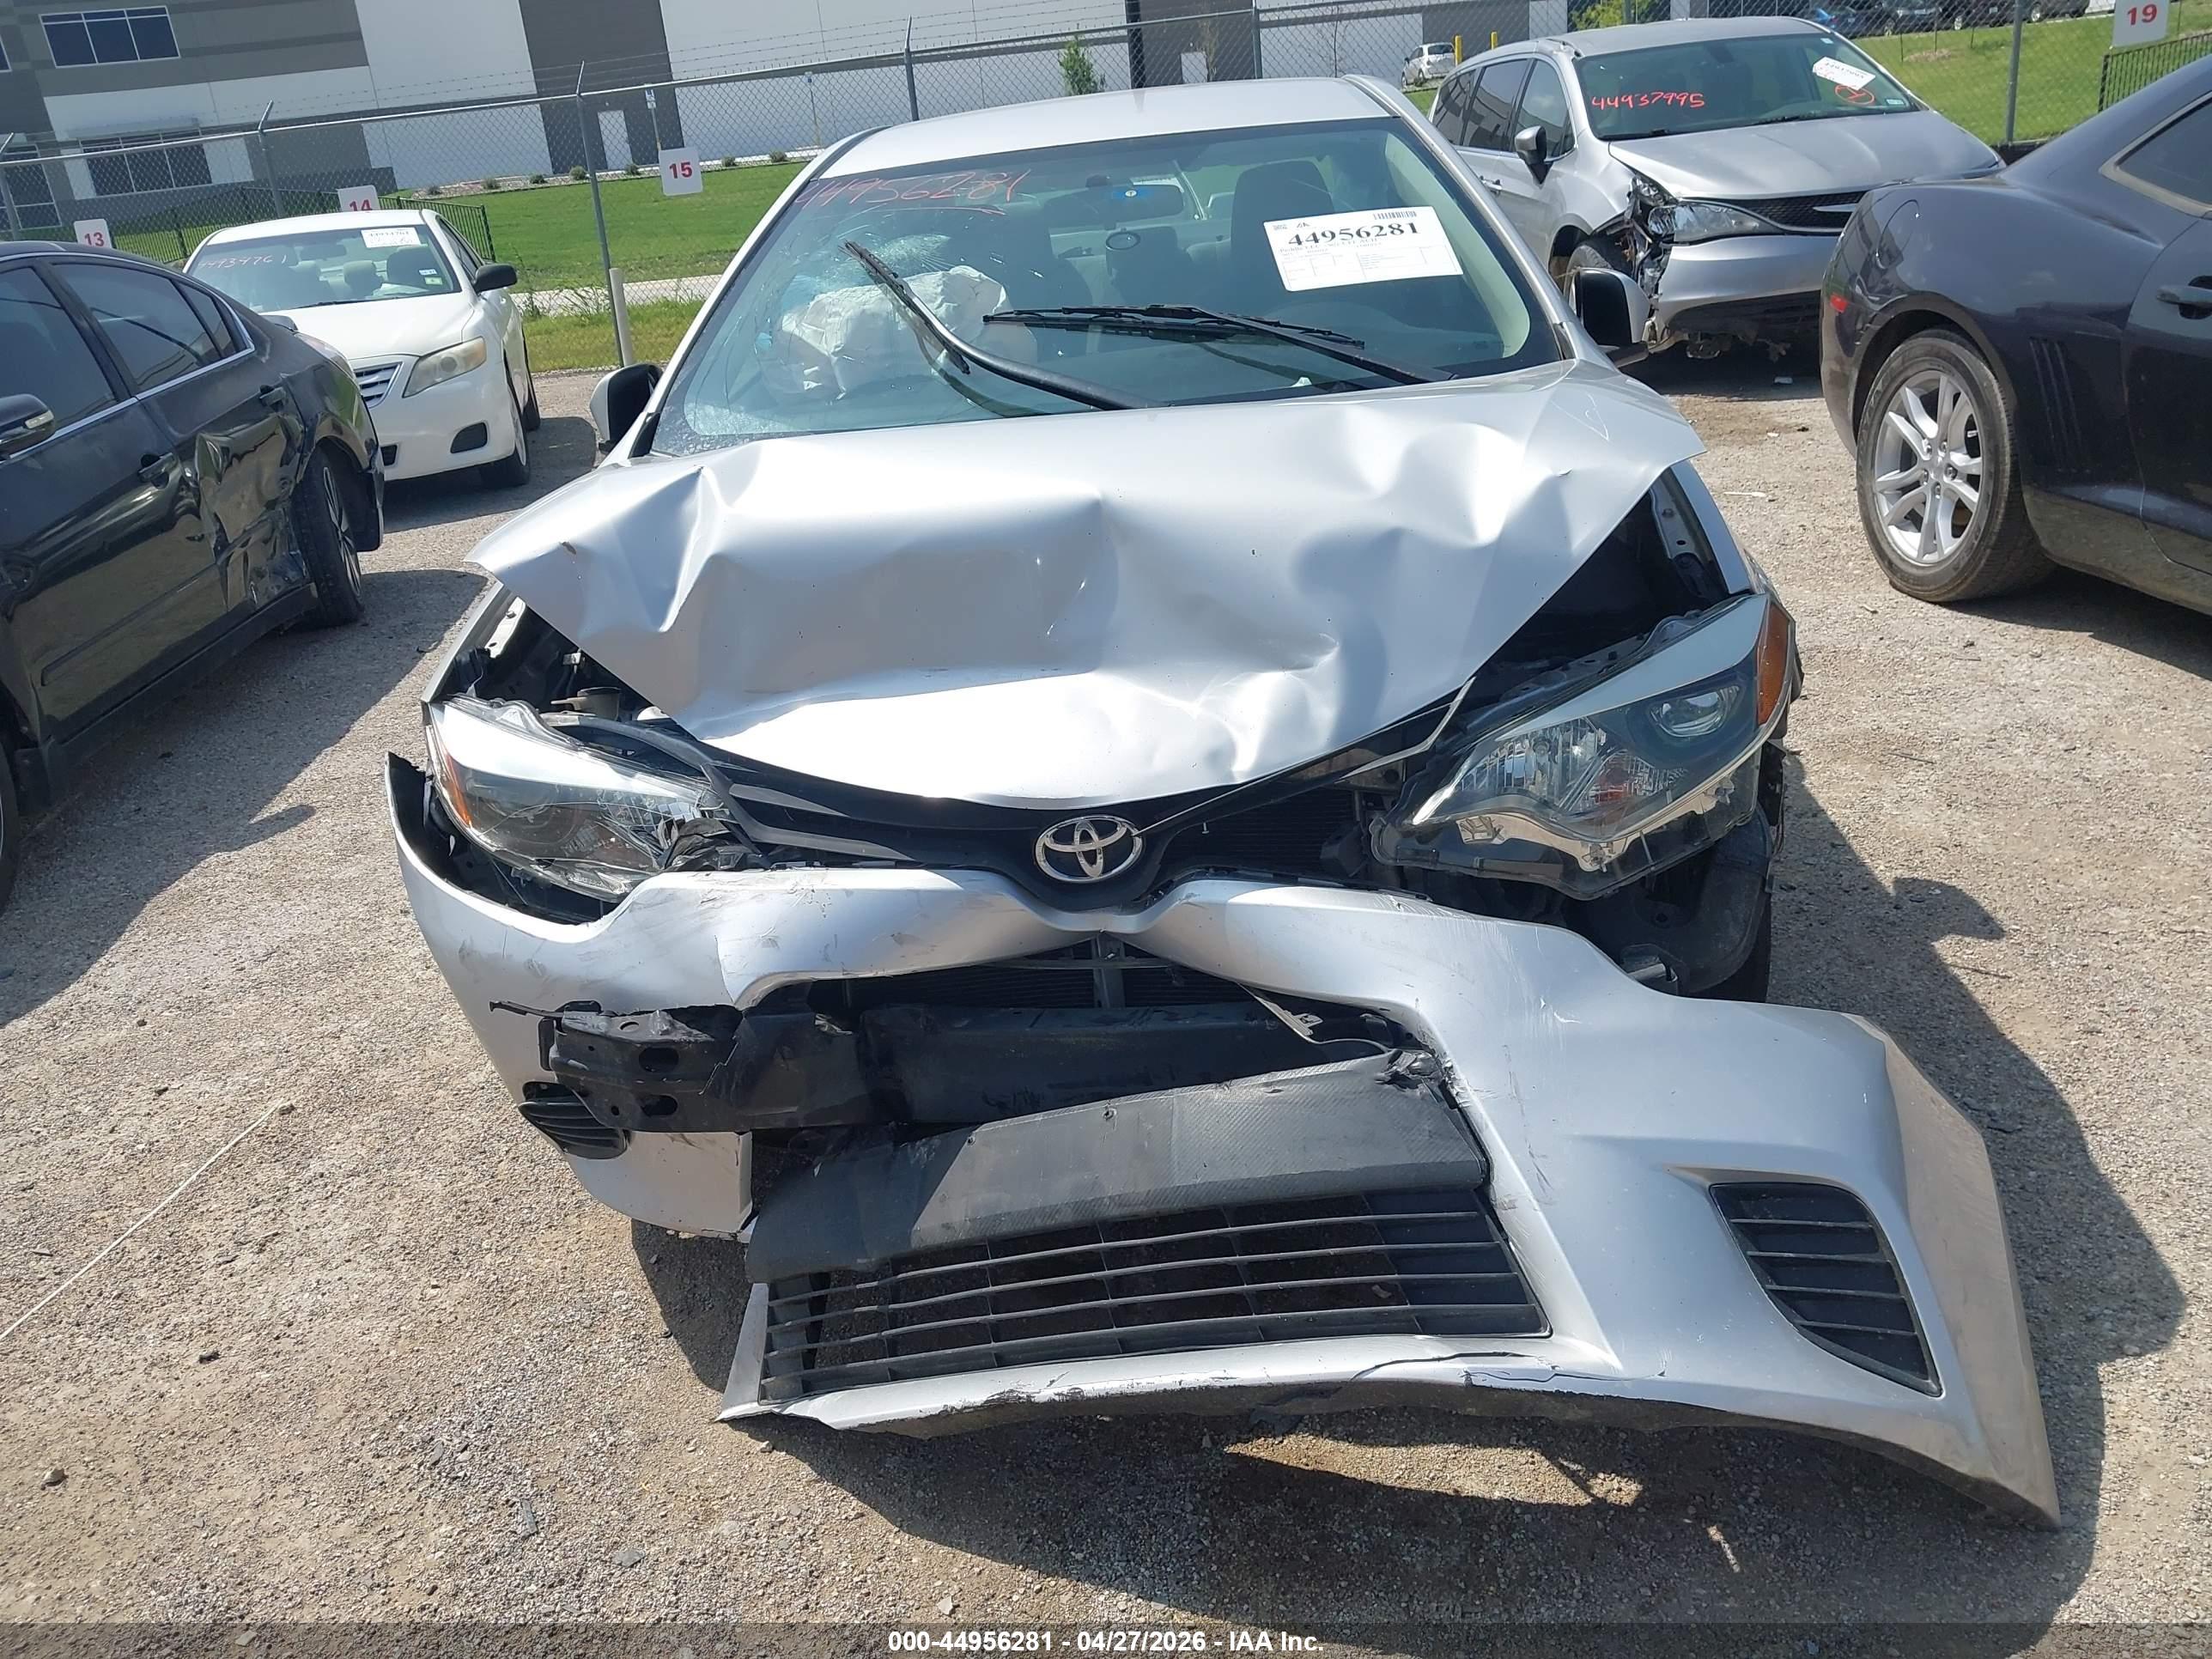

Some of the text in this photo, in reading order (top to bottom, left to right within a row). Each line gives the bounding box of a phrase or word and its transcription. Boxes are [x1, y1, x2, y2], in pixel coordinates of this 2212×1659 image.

[2127, 3, 2157, 26] 19
[669, 161, 693, 179] 15
[795, 169, 1031, 209] 44956281
[349, 199, 373, 212] 14
[84, 232, 105, 246] 13
[1288, 222, 1422, 246] 44956281
